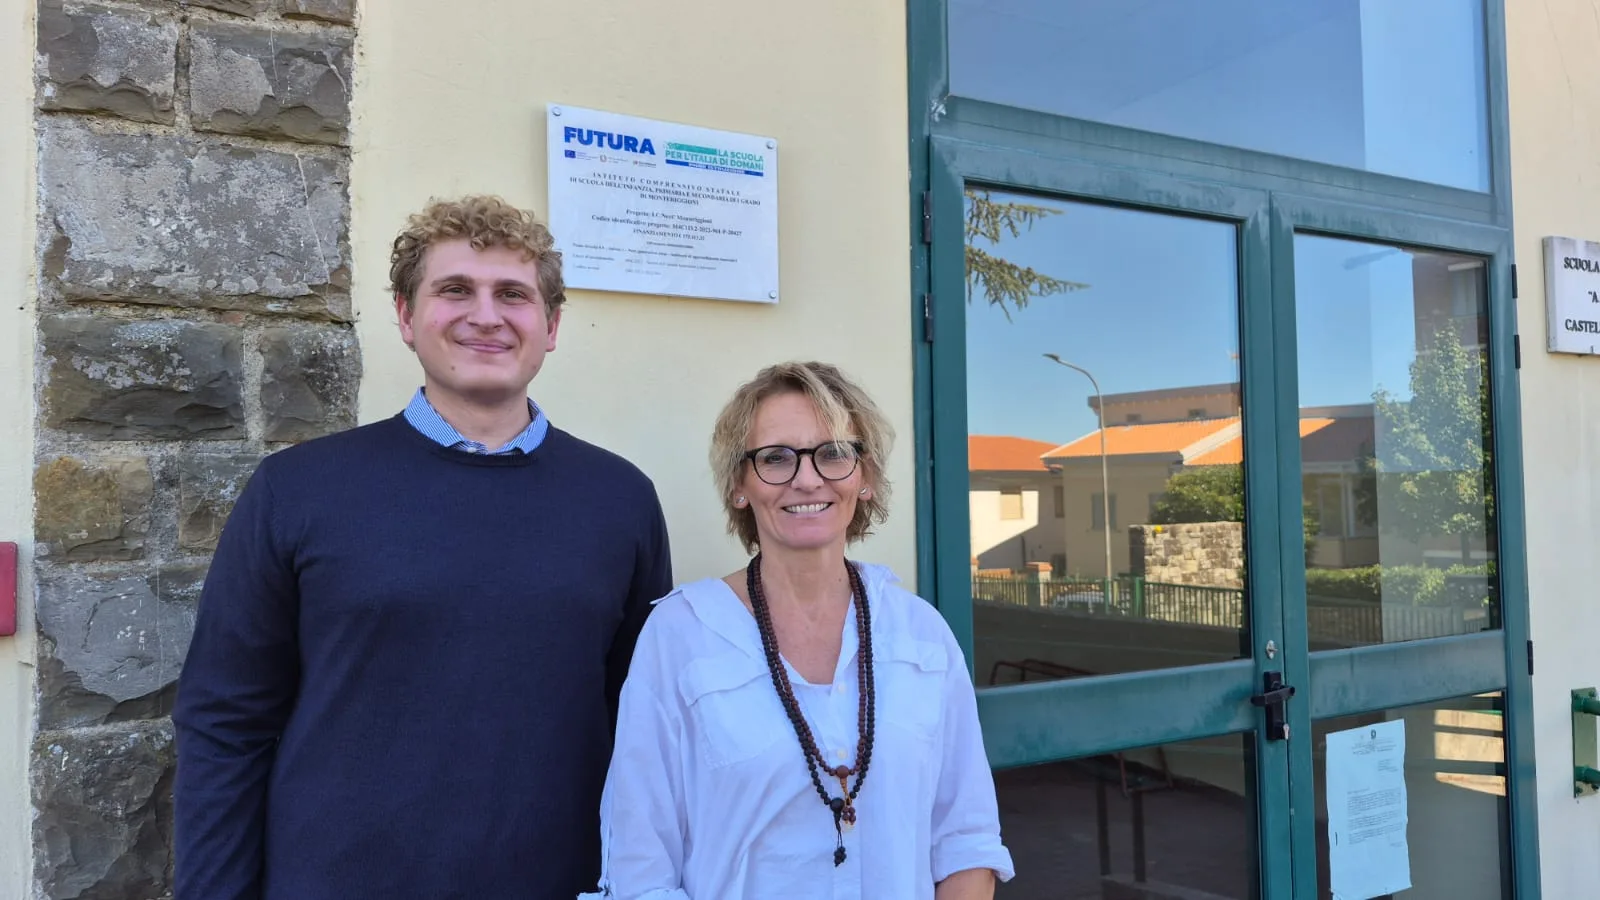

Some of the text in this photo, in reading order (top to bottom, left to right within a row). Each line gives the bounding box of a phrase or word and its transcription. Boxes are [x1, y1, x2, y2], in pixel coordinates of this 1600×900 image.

[564, 126, 656, 155] FUTURA
[666, 150, 682, 160] PER
[684, 152, 718, 165] L'ITALIA
[730, 158, 764, 170] DOMANI
[718, 148, 764, 162] LA SCUOLA
[578, 178, 604, 186] SCUOLA
[692, 192, 729, 202] SECONDARIA
[593, 172, 740, 196] ISTITUTO COMPRENSIVO STATALE
[648, 194, 699, 205] MONTERIGGIONI
[612, 216, 647, 226] identificativo
[1564, 256, 1600, 272] SCUOLA
[1588, 290, 1600, 303] "A
[1565, 318, 1600, 334] CASTEL
